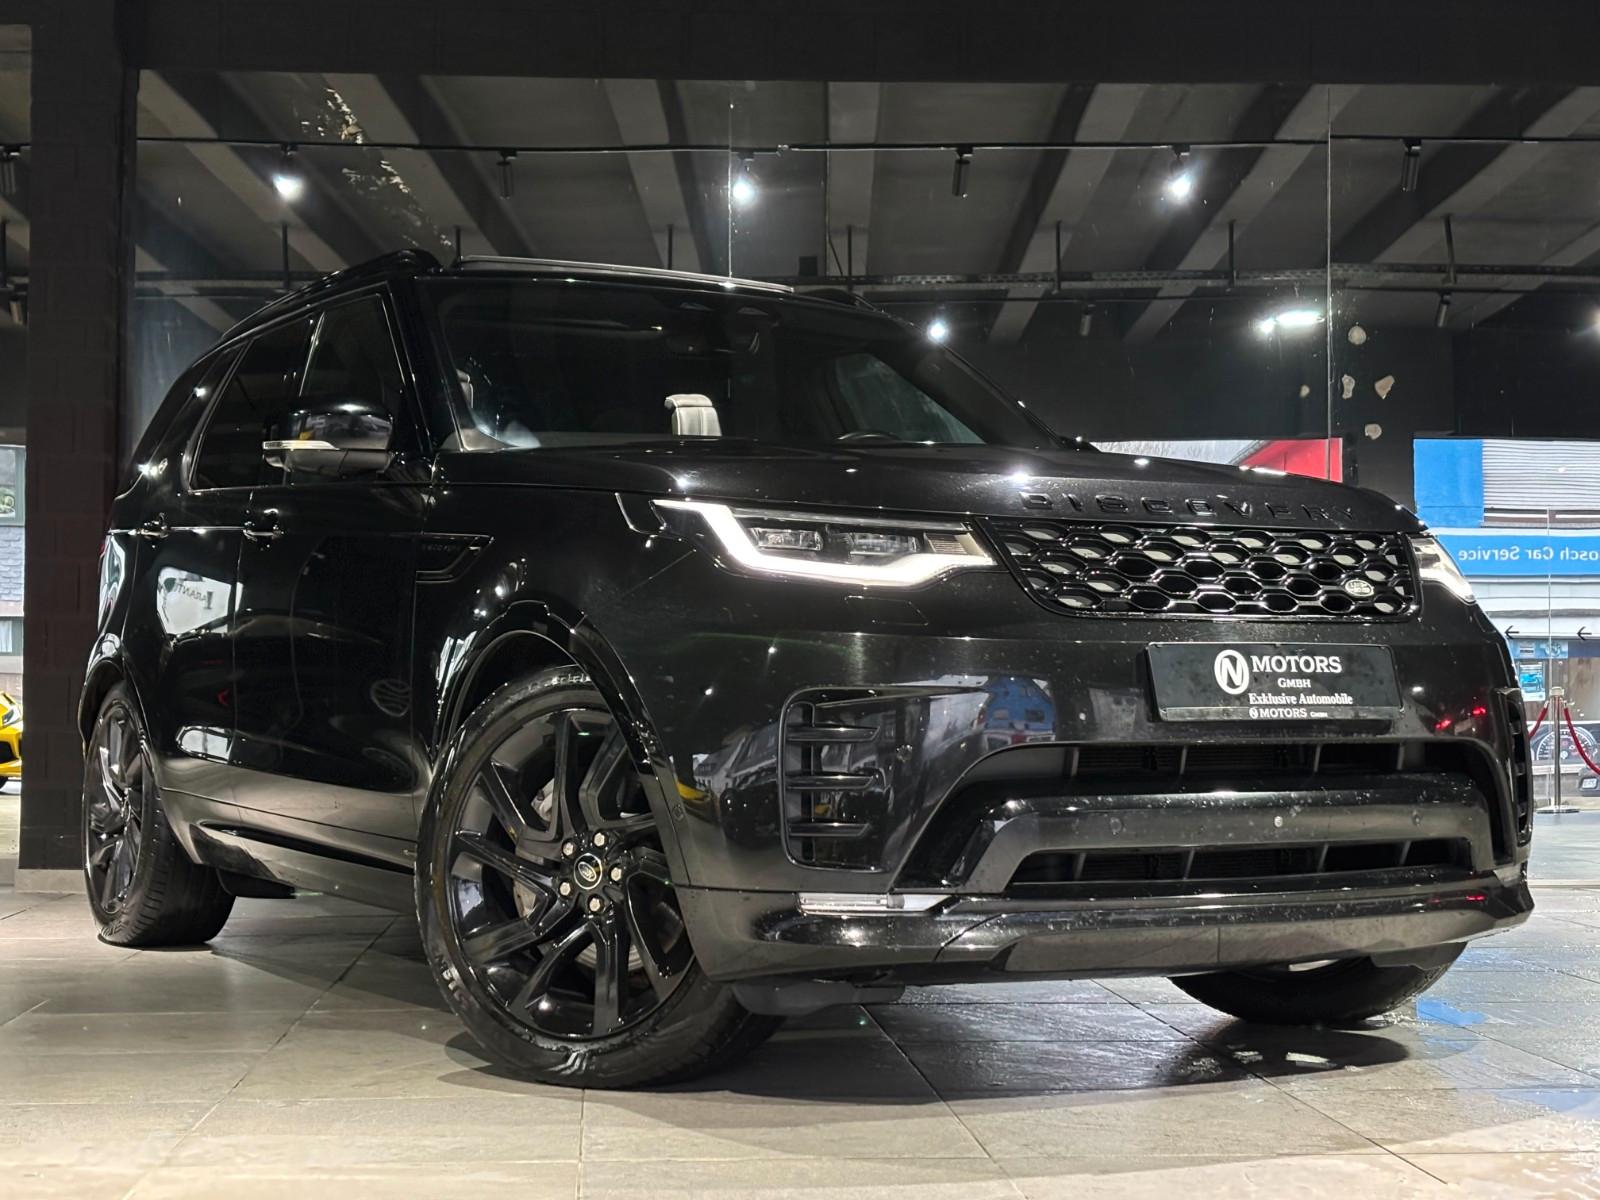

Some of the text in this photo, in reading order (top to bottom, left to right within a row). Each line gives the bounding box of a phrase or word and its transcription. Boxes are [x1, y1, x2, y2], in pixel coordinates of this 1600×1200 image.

[1019, 491, 1353, 520] DISCOVERY
[1250, 656, 1343, 674] MOTORS
[1277, 678, 1312, 689] GMBH
[1248, 693, 1354, 705] Exklusive Automobile
[1259, 708, 1308, 719] MOTORS
